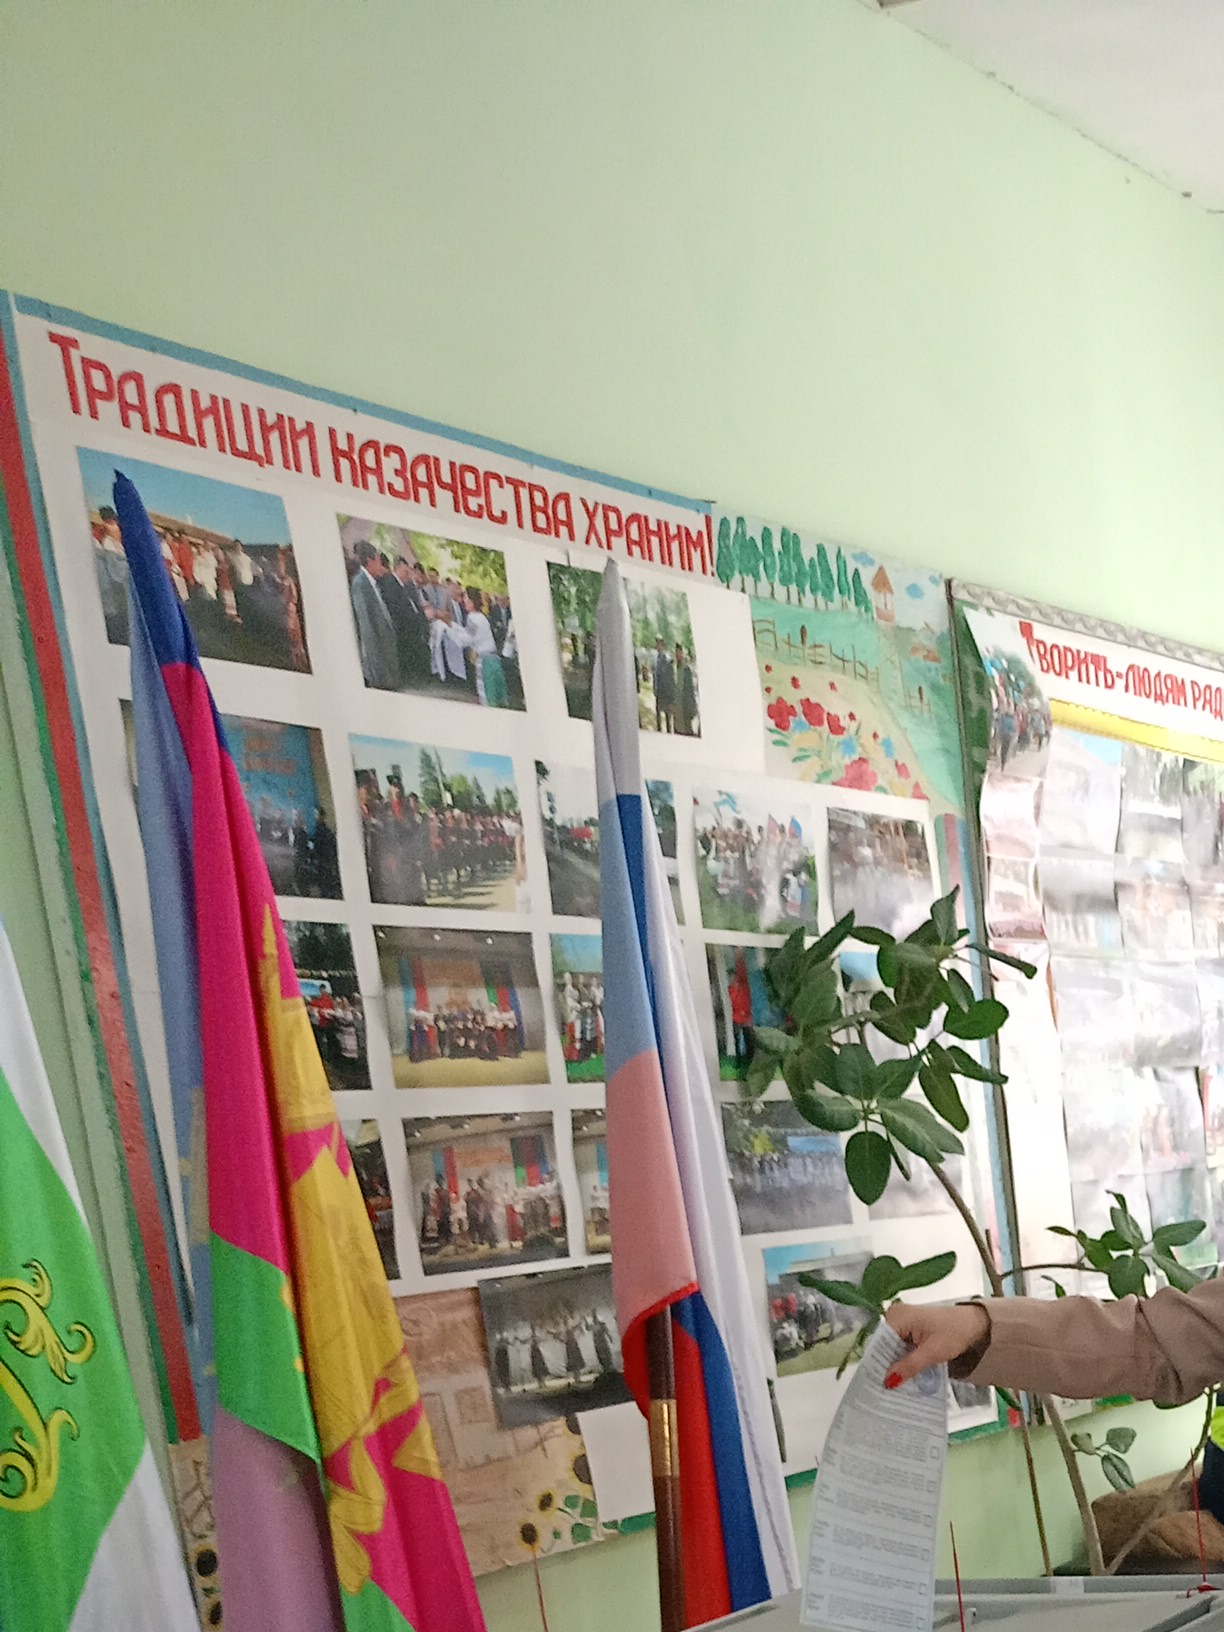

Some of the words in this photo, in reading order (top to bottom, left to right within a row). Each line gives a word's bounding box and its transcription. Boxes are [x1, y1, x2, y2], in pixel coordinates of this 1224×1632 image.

[48, 331, 320, 478] ТРАДИЦИИ
[328, 426, 576, 542] КАЗАЧЕСТВА
[580, 496, 716, 577] ХРАНИМ!
